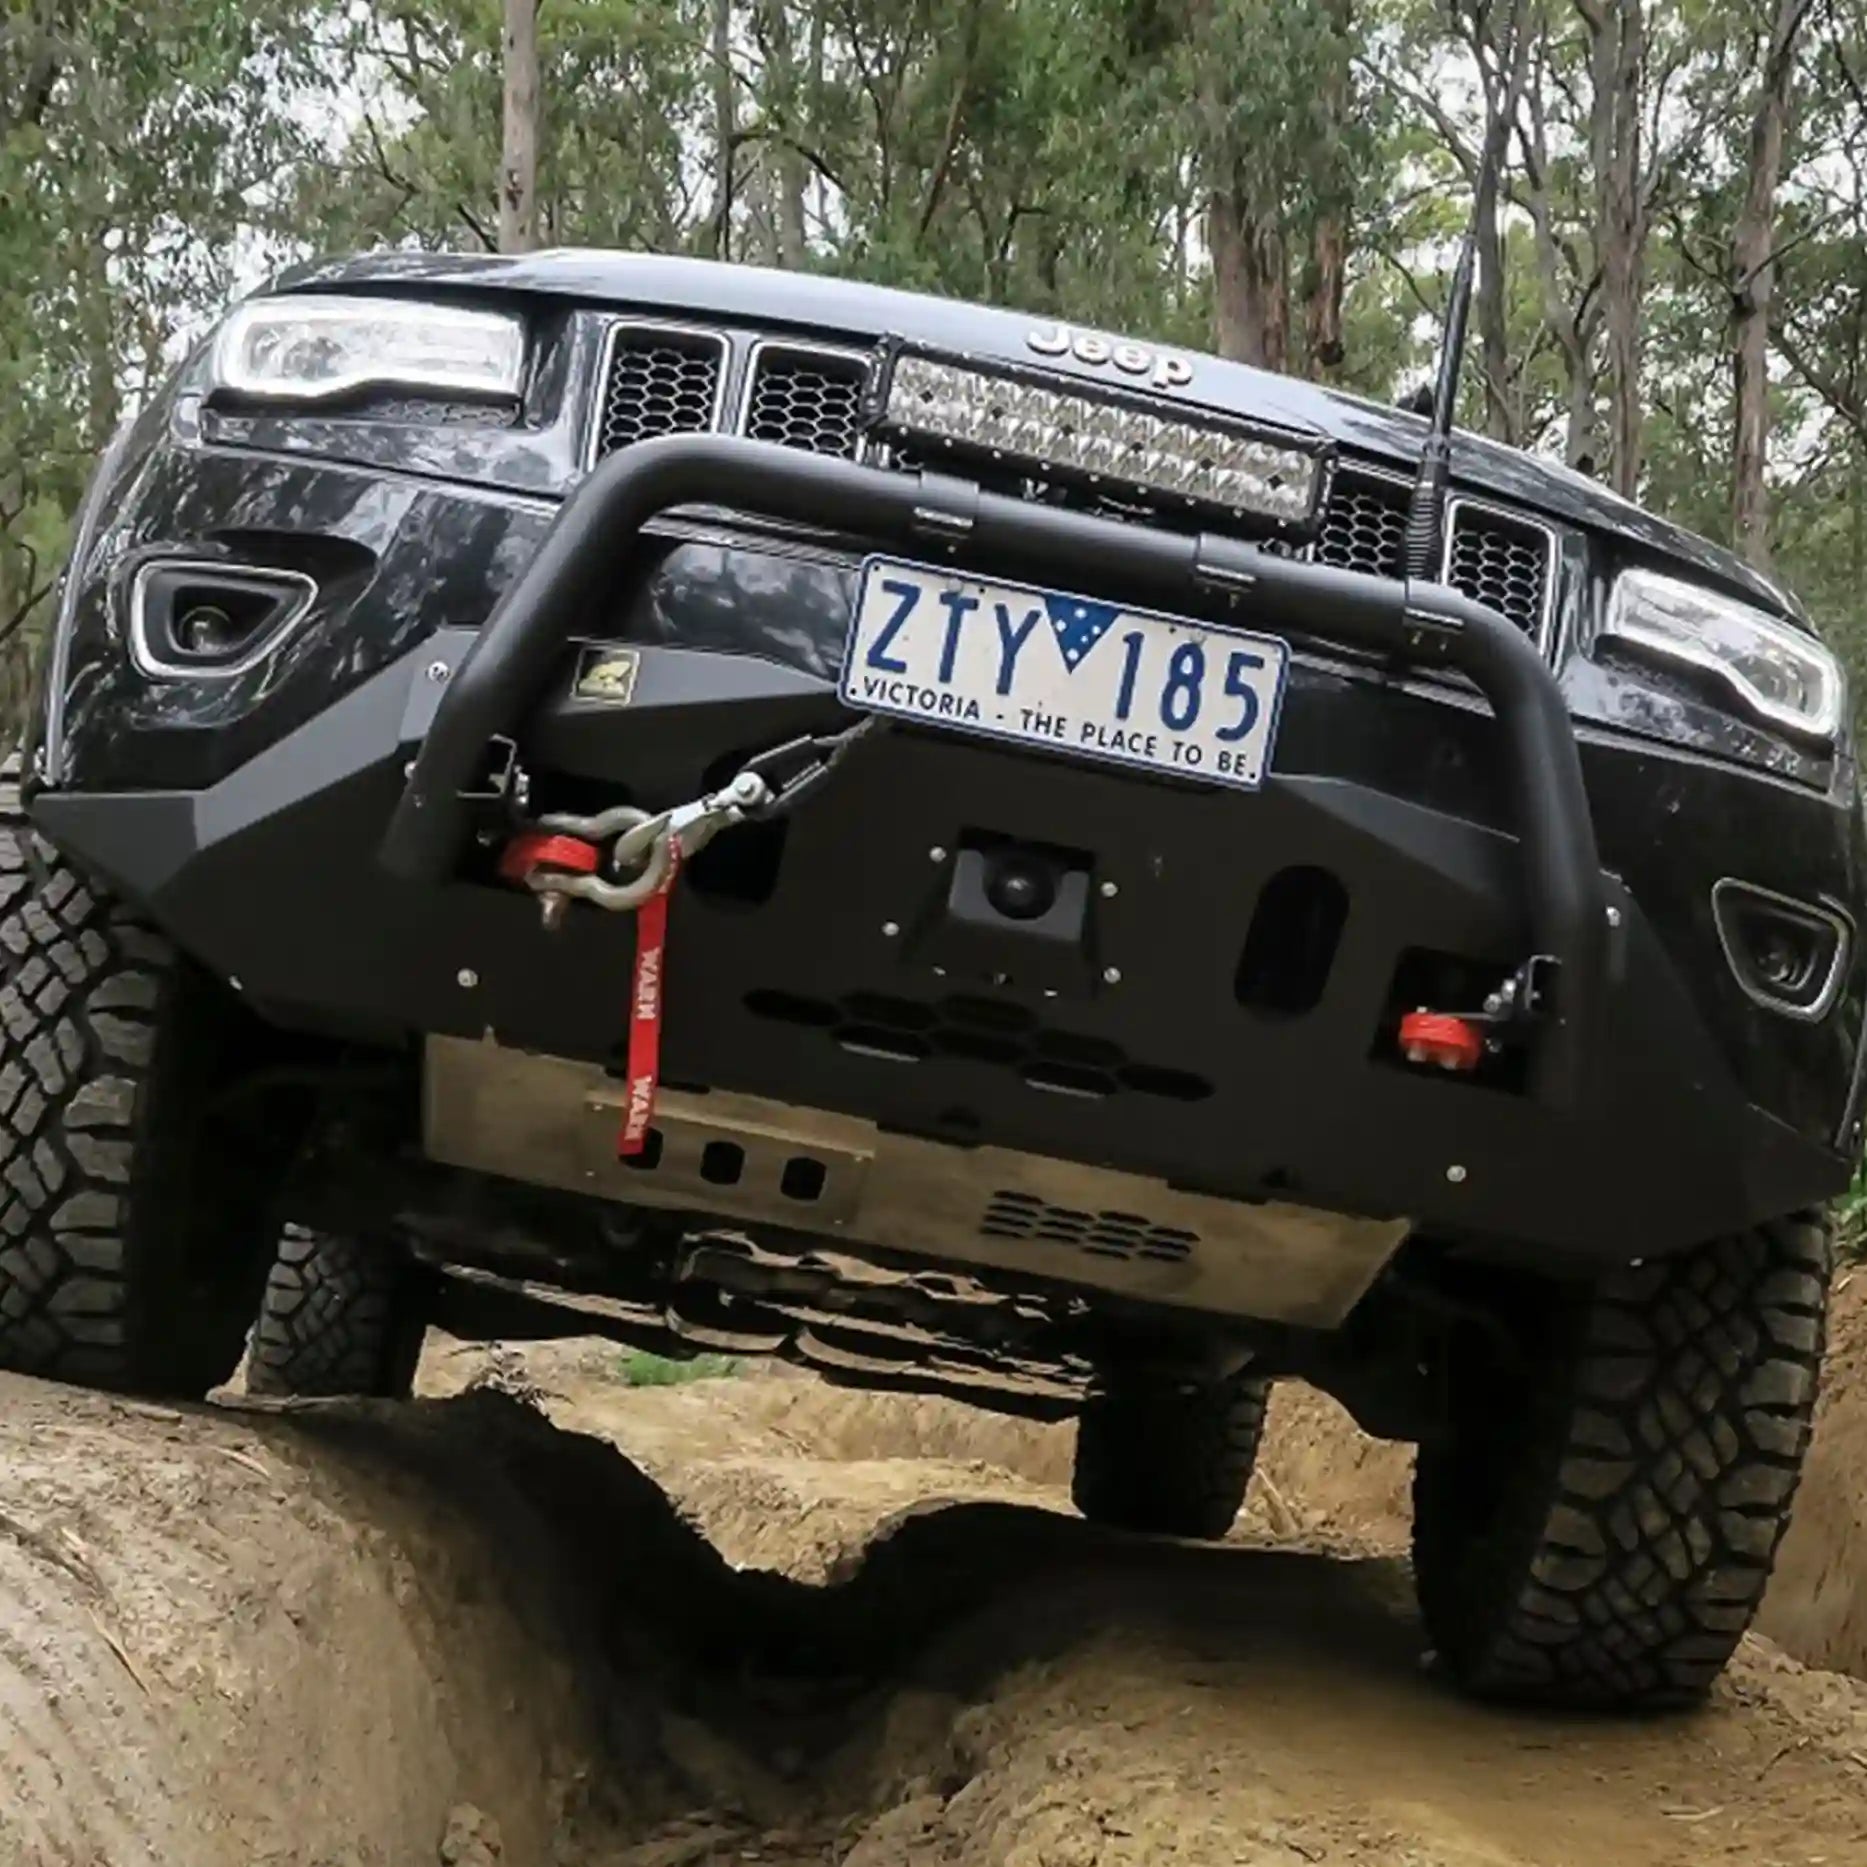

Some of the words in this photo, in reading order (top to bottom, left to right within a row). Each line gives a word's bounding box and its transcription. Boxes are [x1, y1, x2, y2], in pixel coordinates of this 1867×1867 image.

[1026, 326, 1192, 389] Jeep
[866, 579, 1042, 696] ZTY
[1114, 630, 1265, 742] 185
[863, 675, 981, 721] VICTORIA
[1020, 708, 1066, 738] THE
[1080, 721, 1157, 757] PLACE
[1172, 740, 1202, 765] TO
[637, 946, 661, 1020] WARN
